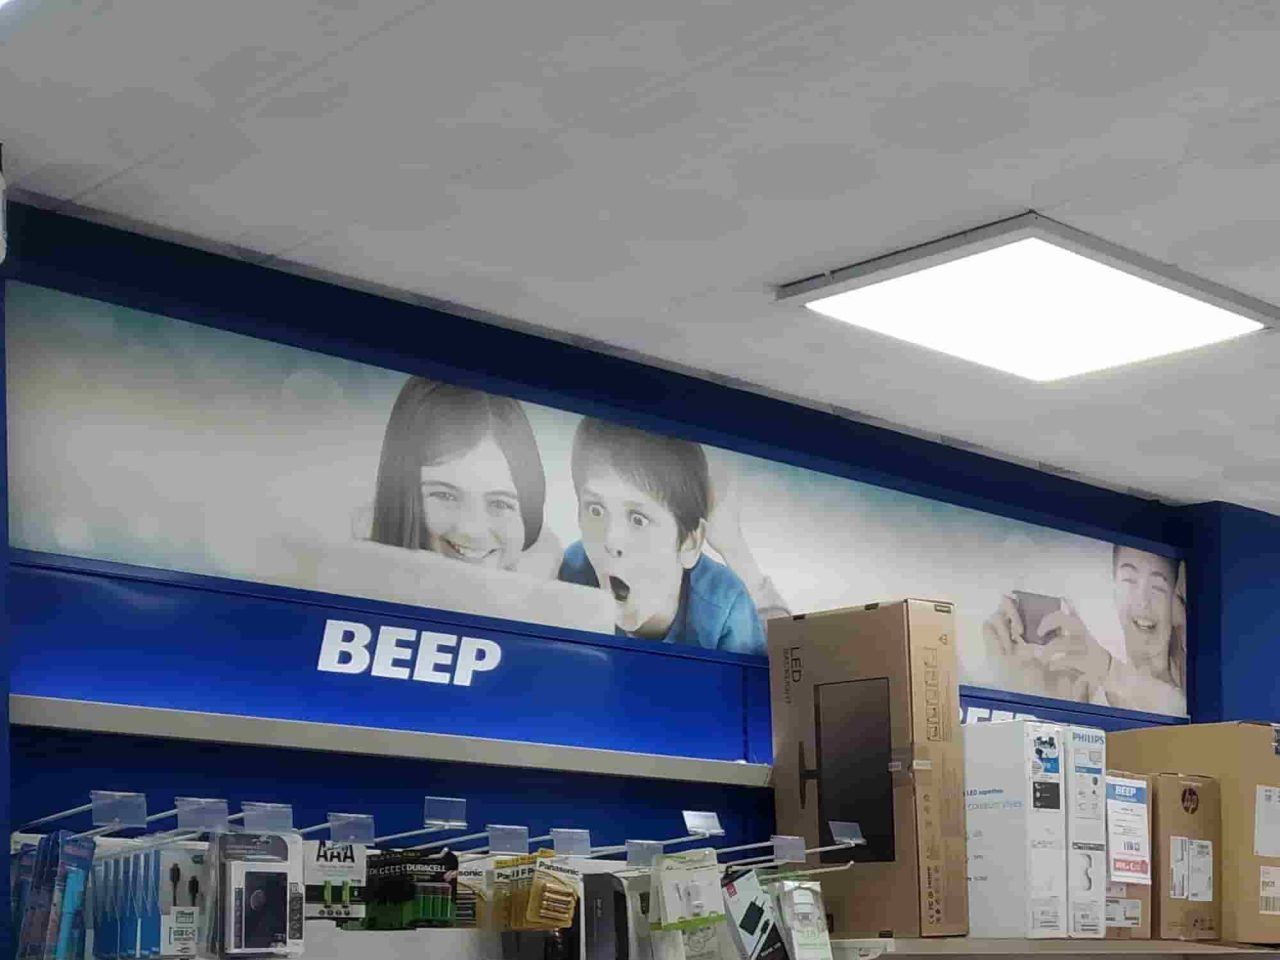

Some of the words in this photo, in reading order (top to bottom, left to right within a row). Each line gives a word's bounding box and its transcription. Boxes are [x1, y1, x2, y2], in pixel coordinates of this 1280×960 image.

[317, 619, 503, 687] BEEP
[790, 646, 801, 683] LED
[1072, 731, 1105, 745] PHILIPS
[1115, 786, 1137, 797] BEEP
[316, 841, 355, 863] AAA
[407, 863, 447, 874] DURACELL
[458, 869, 484, 878] sonic
[538, 861, 580, 878] Panasonic
